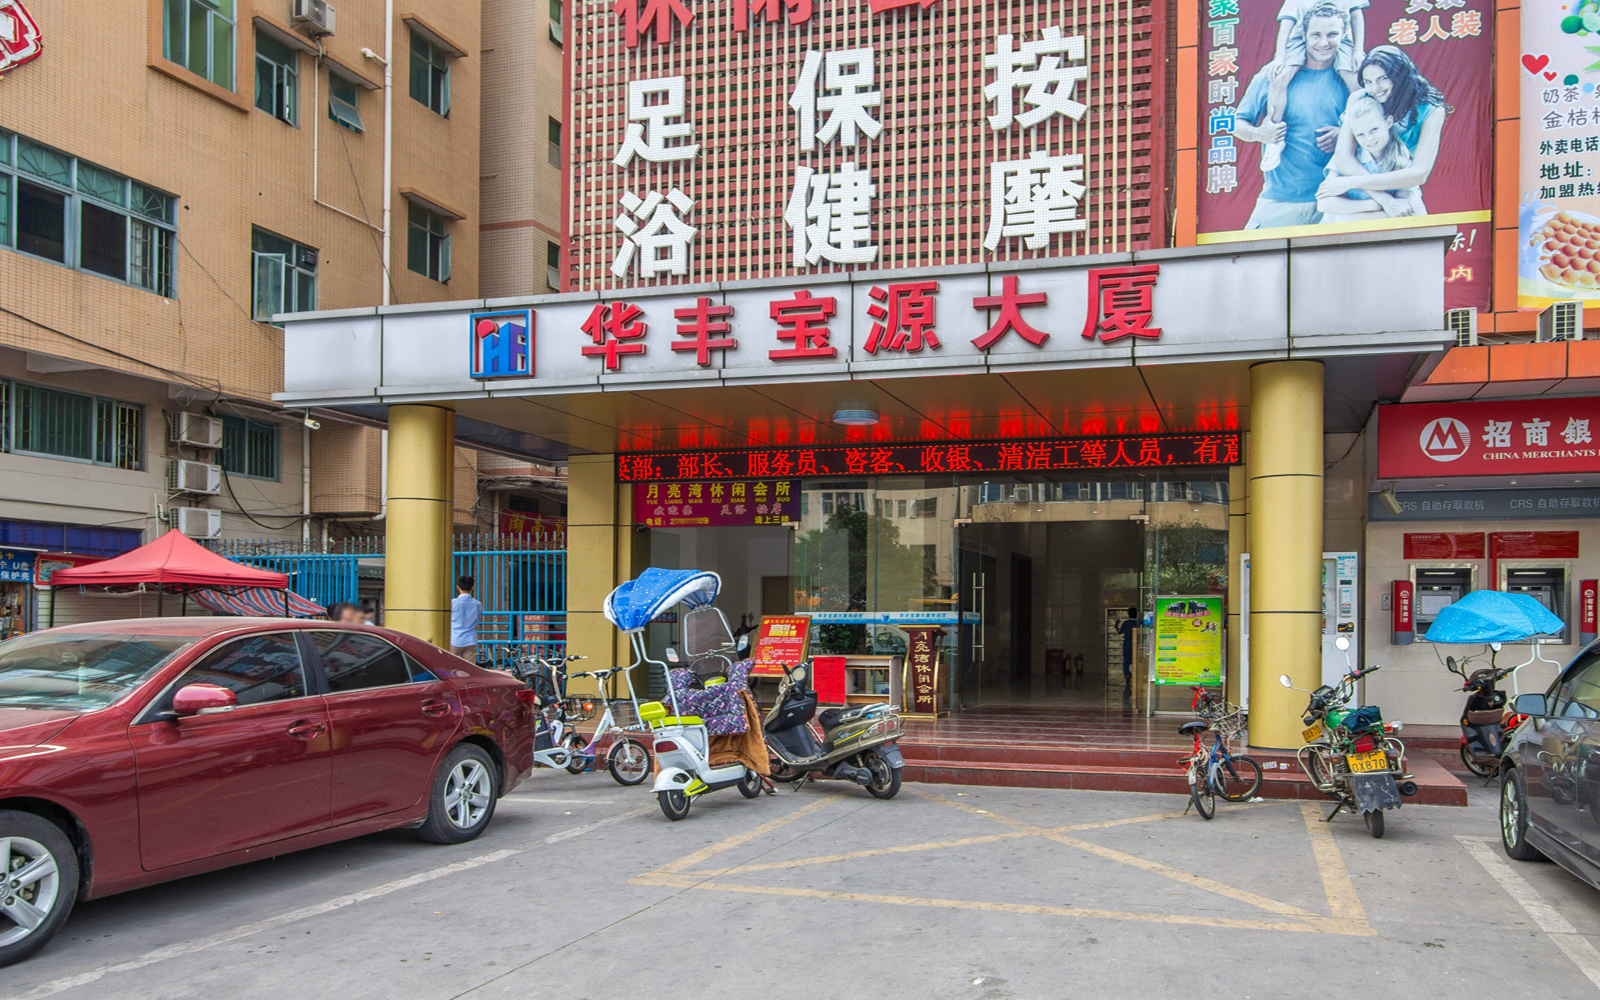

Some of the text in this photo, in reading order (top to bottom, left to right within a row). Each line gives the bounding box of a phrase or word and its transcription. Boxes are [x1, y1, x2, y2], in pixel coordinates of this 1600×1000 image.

[1388, 10, 1482, 45] 老人装
[1543, 87, 1579, 104] 奶茶
[983, 25, 1088, 252] 按摩
[1539, 136, 1600, 156] 外卖电话
[784, 47, 883, 269] 保健
[611, 75, 700, 279] 足浴
[1539, 181, 1600, 199] 加盟热
[580, 265, 1163, 371] 华丰宝源大厦
[1483, 451, 1520, 460] CHINA
[1522, 449, 1596, 459] MERCHANTS
[646, 481, 792, 499] 月亮湾休闲会所
[1509, 499, 1534, 509] CRS
